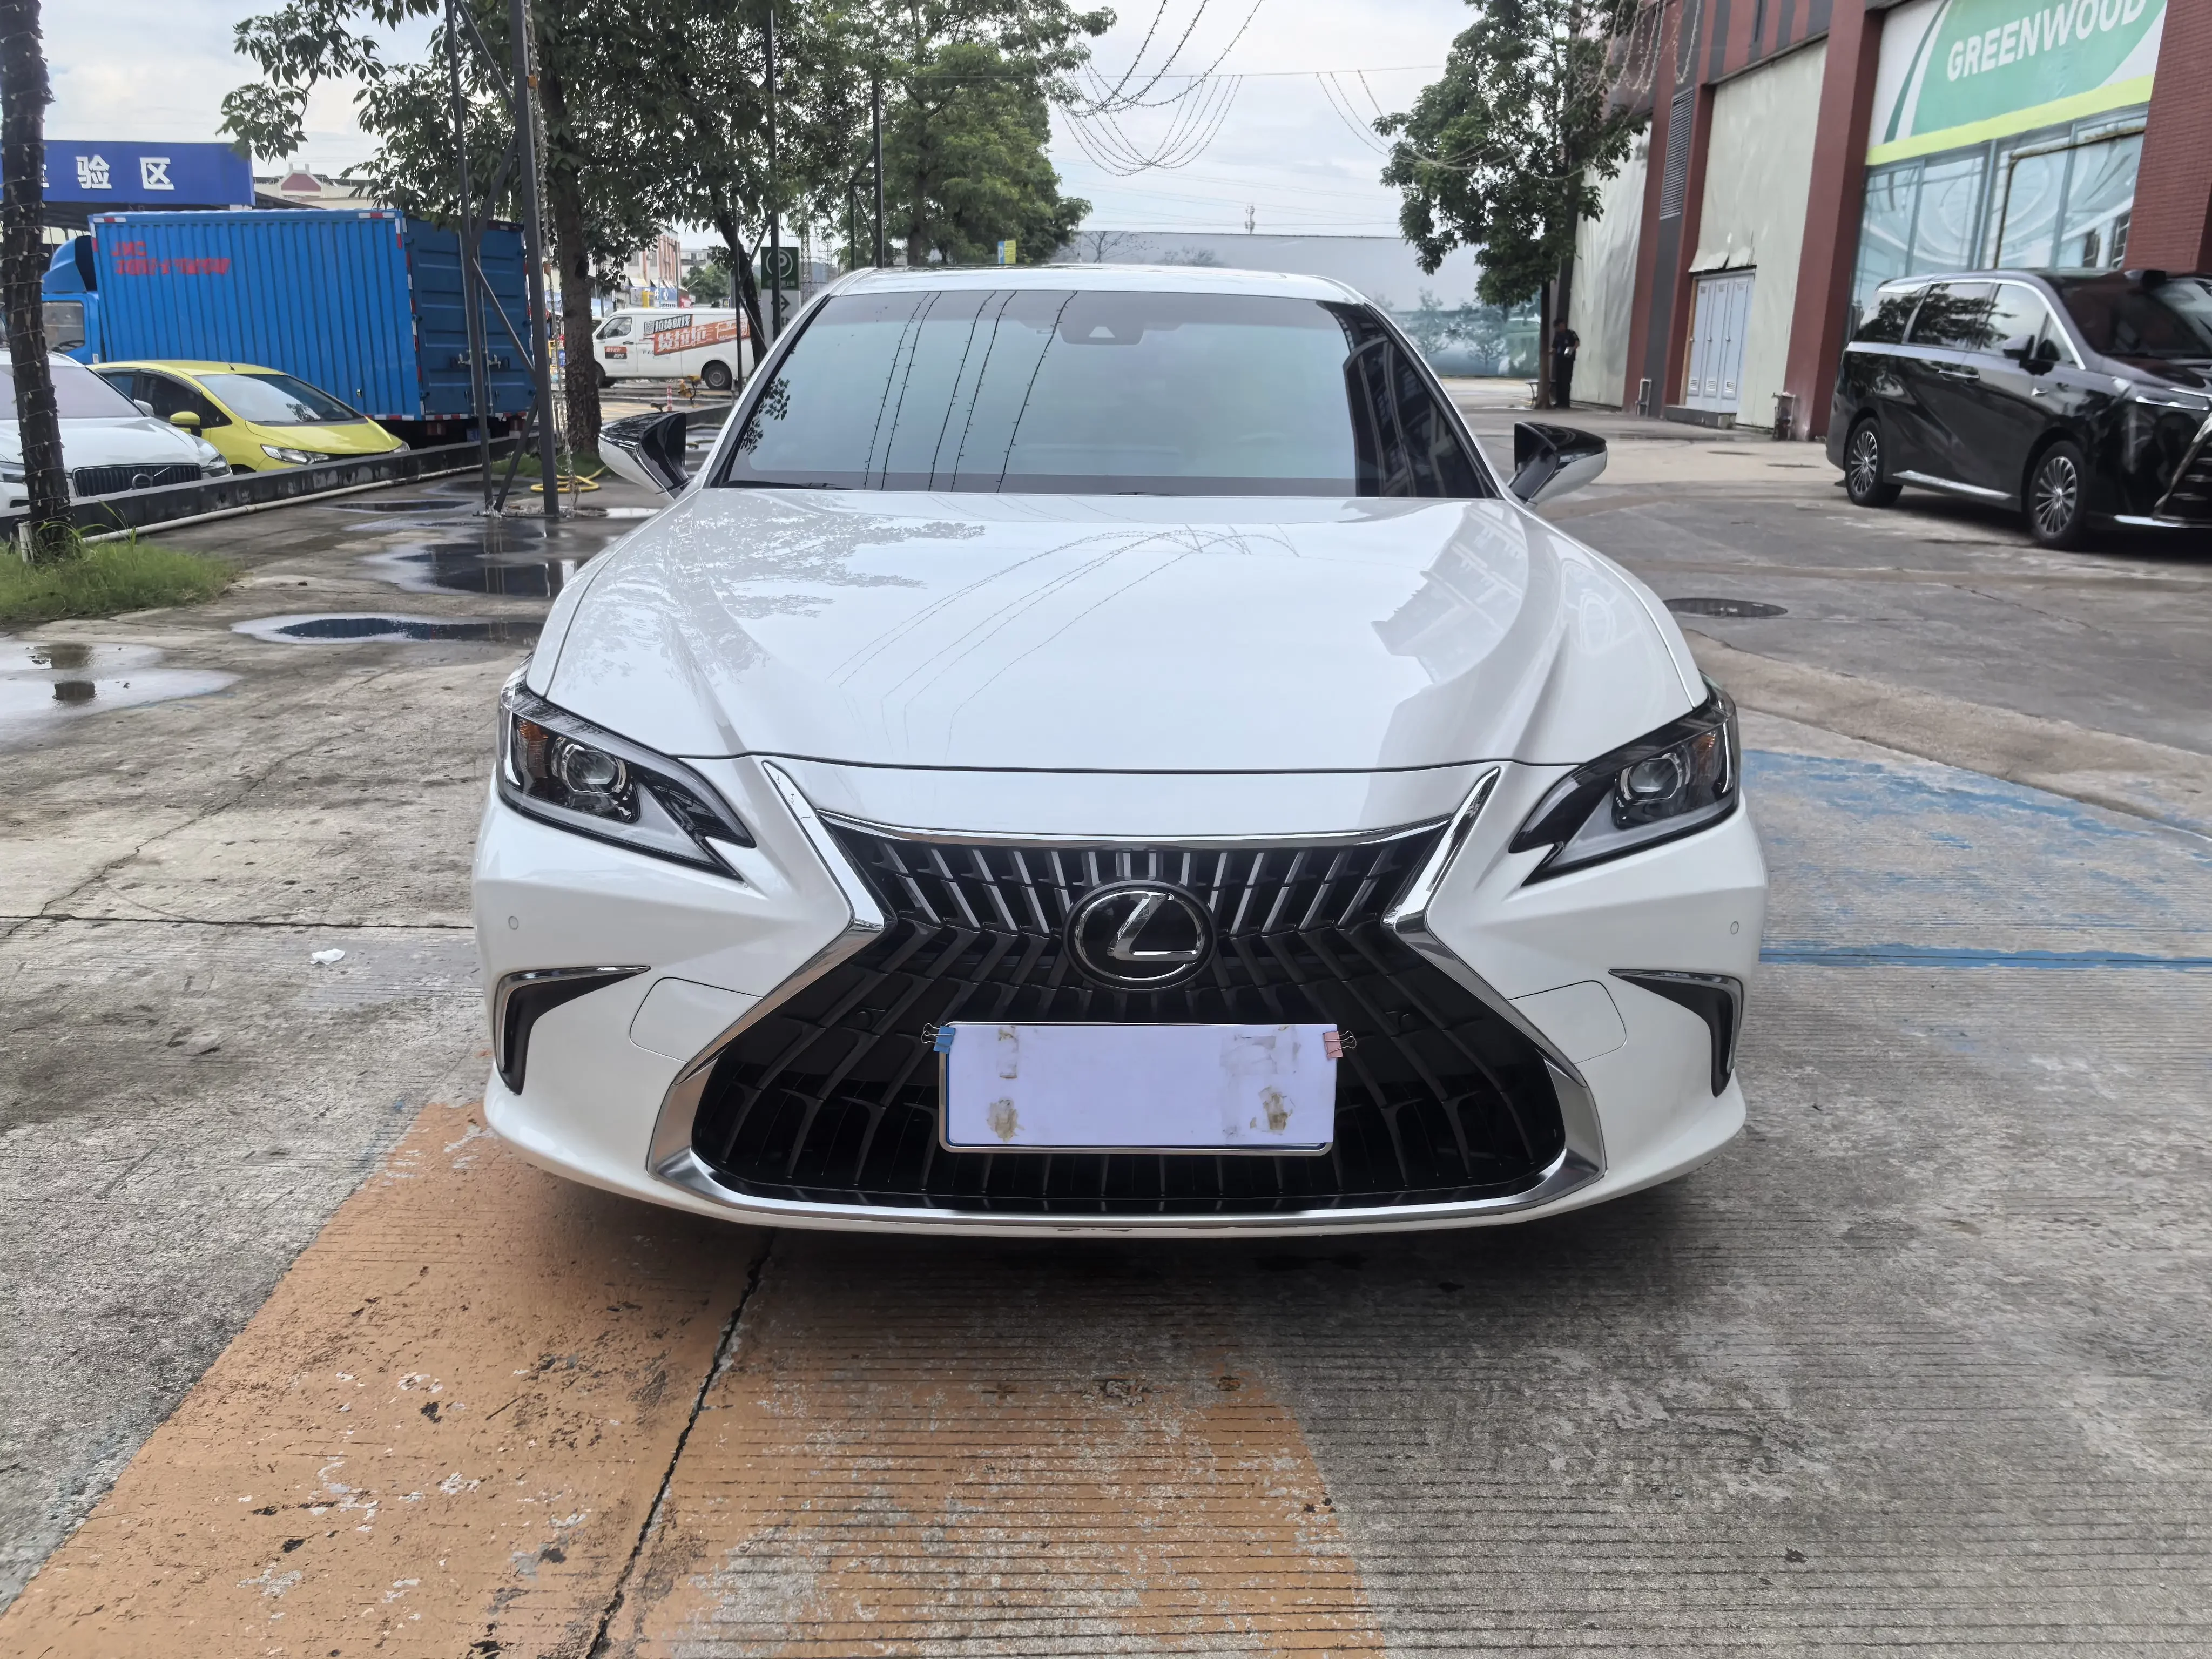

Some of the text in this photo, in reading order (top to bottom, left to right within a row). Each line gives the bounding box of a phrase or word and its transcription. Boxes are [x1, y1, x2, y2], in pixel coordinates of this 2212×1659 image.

[1947, 0, 2146, 82] GREENWOOD
[42, 154, 174, 190] 验区
[657, 326, 706, 352] 货拉拉
